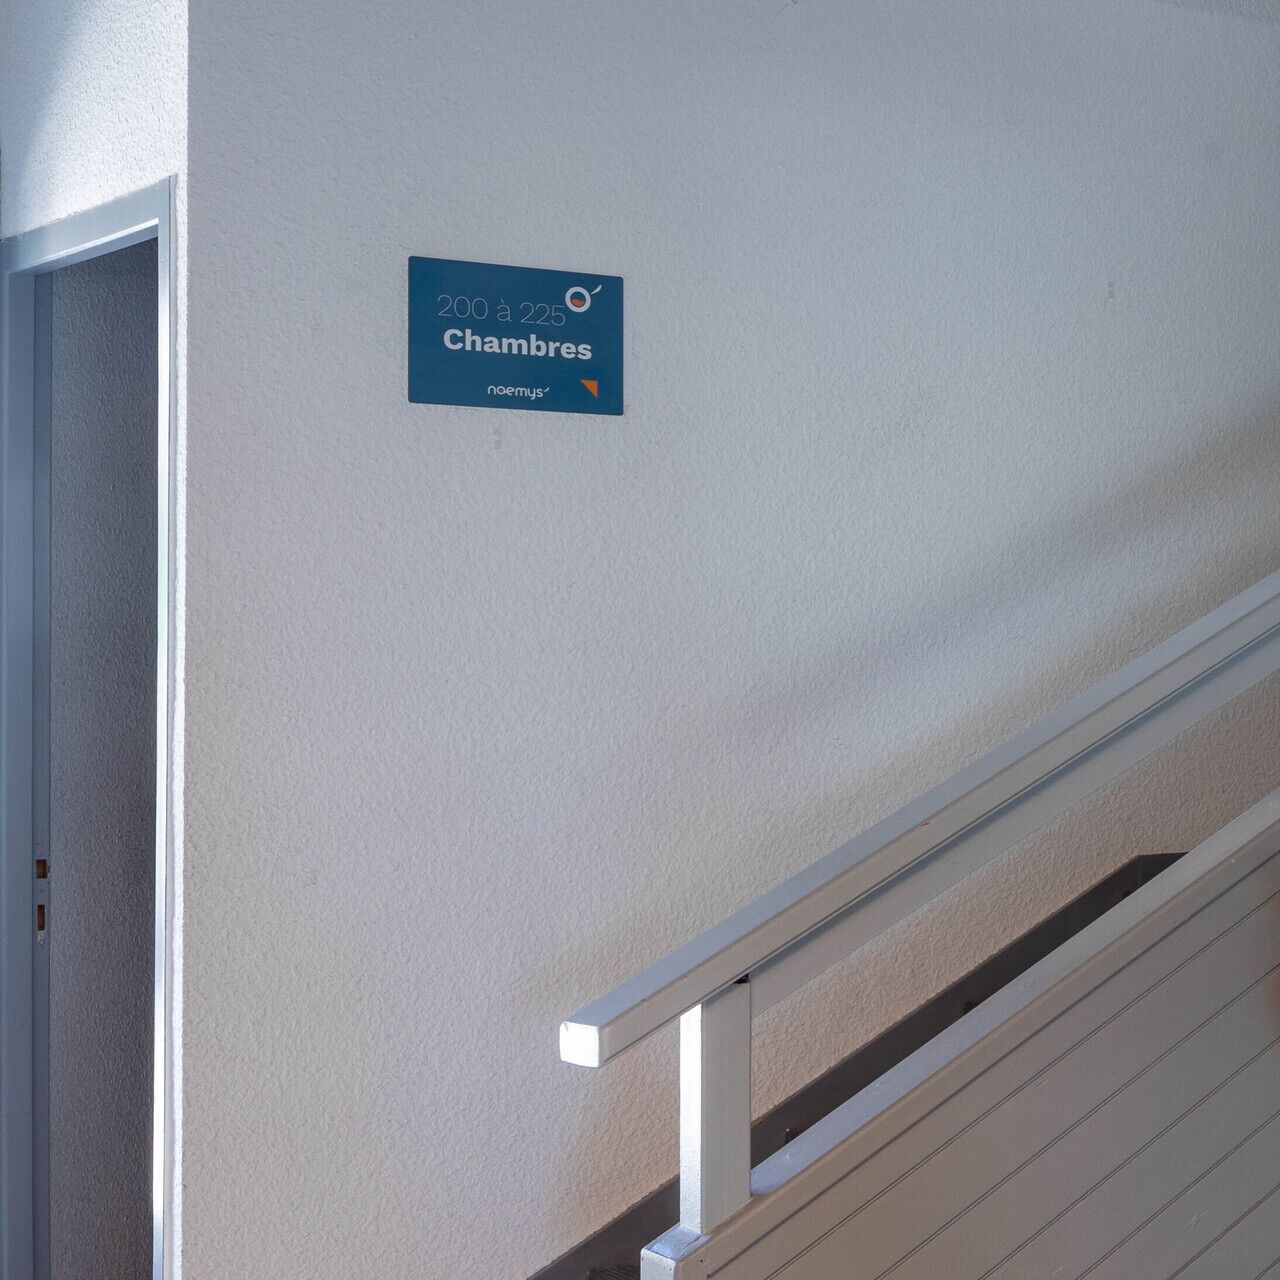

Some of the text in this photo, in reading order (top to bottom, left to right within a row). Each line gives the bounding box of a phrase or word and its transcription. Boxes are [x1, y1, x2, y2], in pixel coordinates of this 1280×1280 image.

[437, 294, 566, 326] 200 à 225
[443, 328, 592, 361] Chambres
